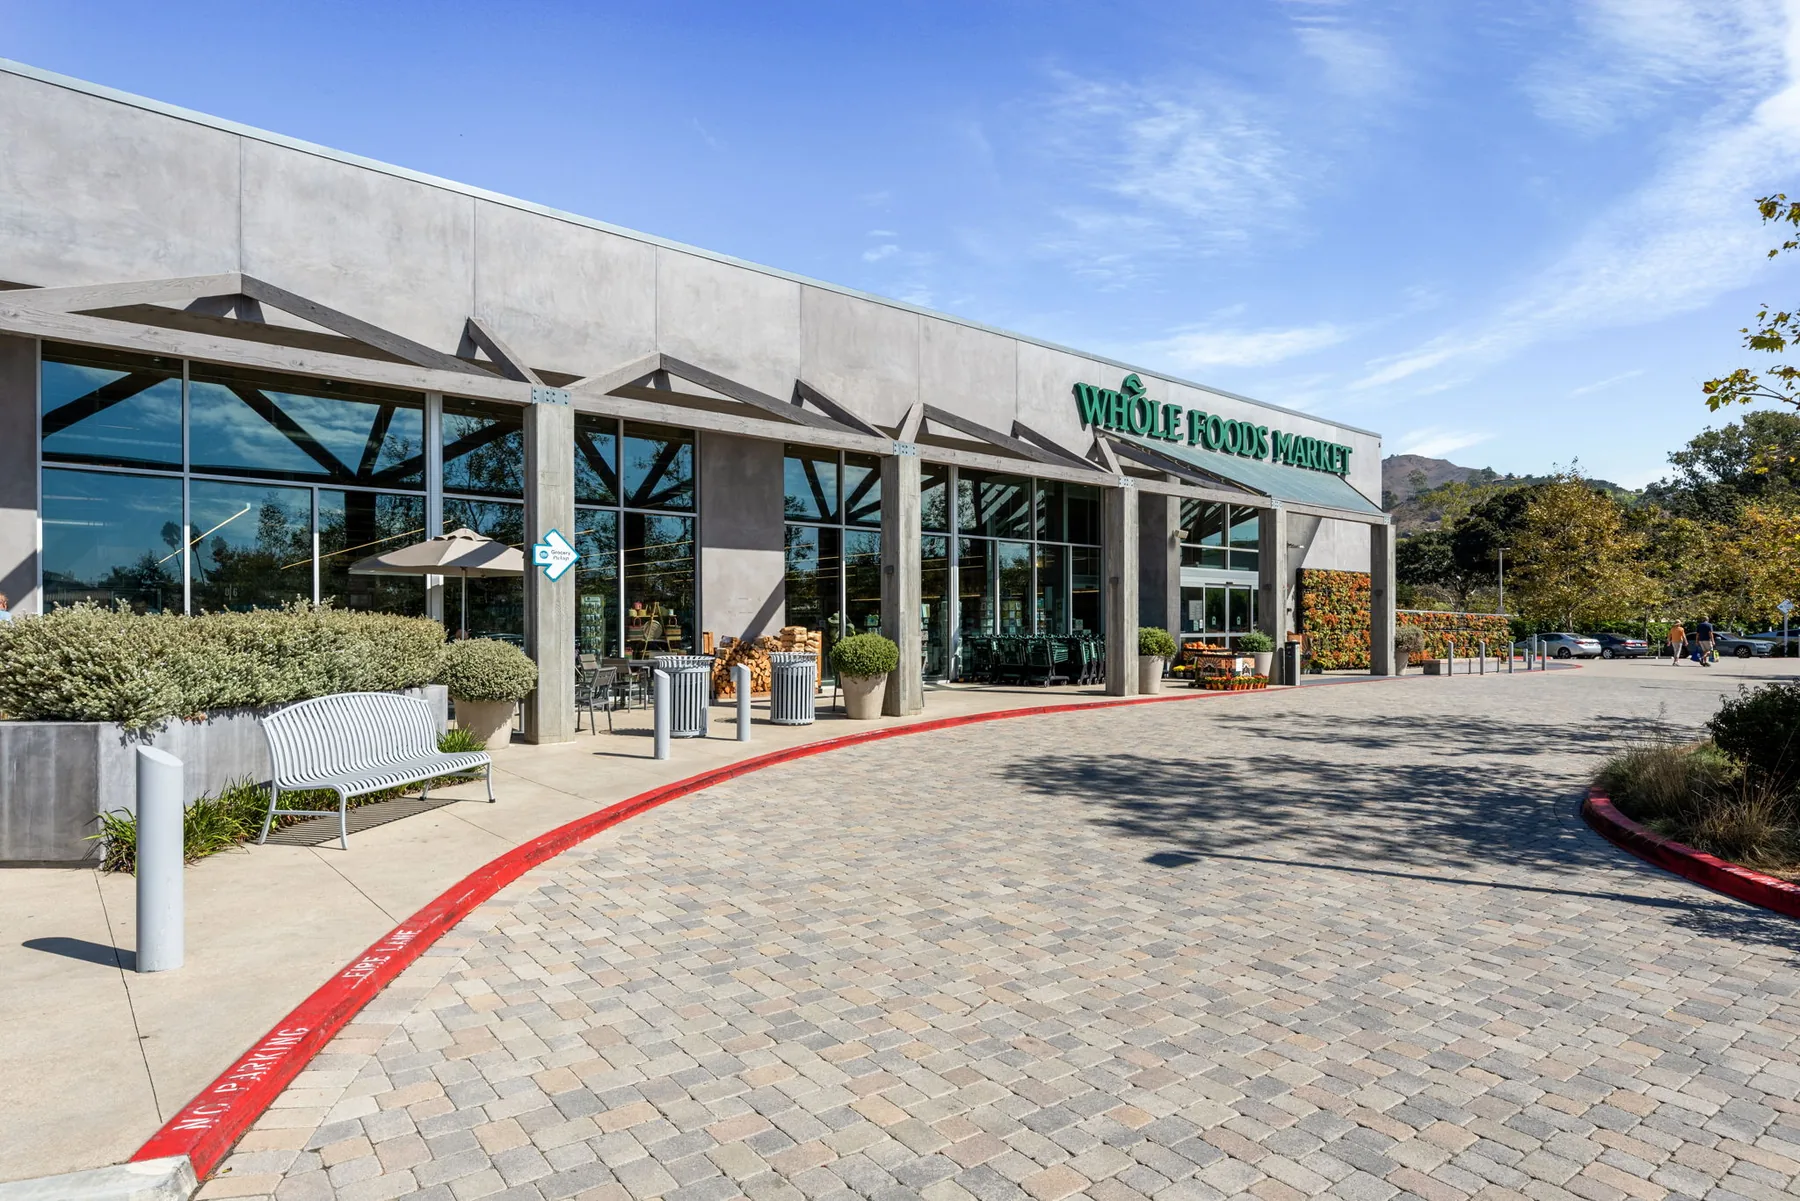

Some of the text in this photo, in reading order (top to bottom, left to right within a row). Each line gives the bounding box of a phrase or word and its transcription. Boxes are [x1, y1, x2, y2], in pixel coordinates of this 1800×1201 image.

[1073, 374, 1353, 477] WHOLE FOODS MARKET
[213, 1027, 309, 1093] PARKING
[342, 956, 391, 980] FIRE
[375, 929, 422, 952] LANE
